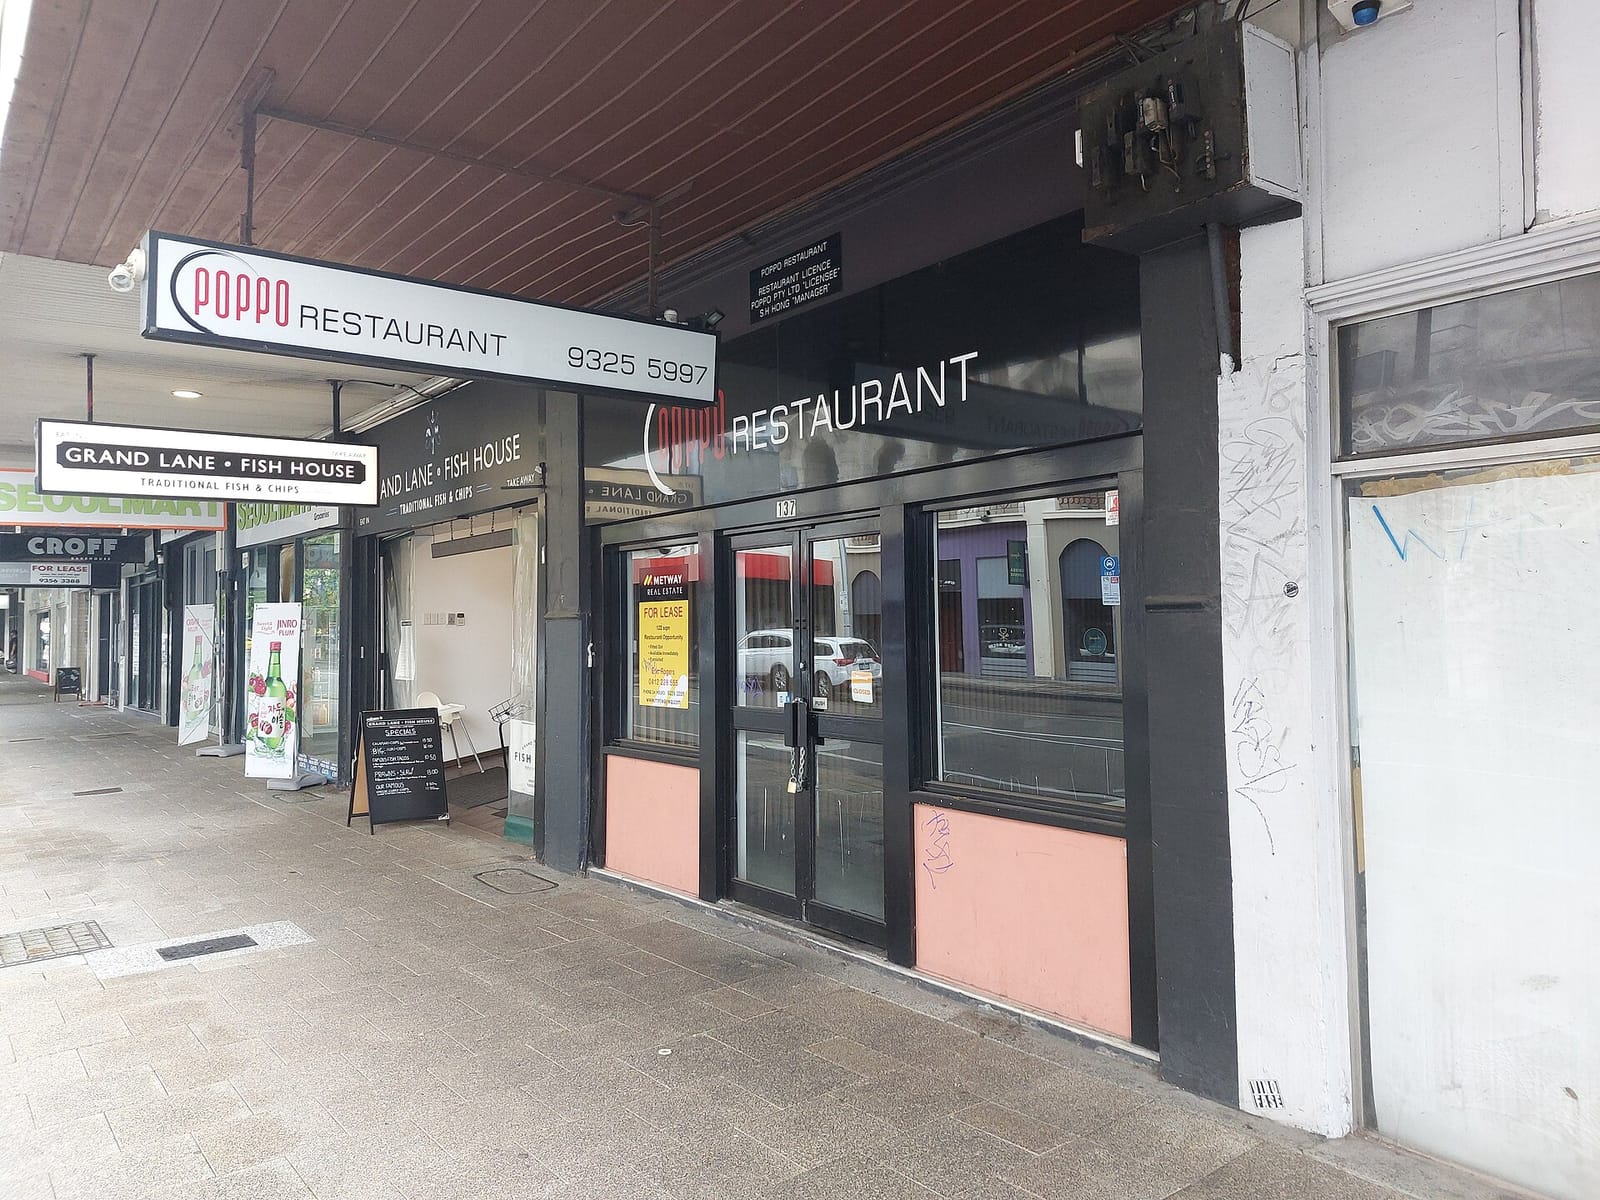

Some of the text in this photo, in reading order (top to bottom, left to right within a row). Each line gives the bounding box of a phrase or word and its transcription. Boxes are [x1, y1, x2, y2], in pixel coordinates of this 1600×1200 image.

[761, 241, 828, 277] POPPO RESTAURANT
[758, 259, 831, 296] RESTAURANT LICENCE
[751, 295, 772, 310] POPPO
[773, 290, 786, 301] PTY
[787, 283, 801, 296] LTD
[771, 299, 790, 313] HONG
[194, 267, 708, 386] POPPO RESTAURANT 9325 5997
[732, 351, 979, 454] RESTAURANT
[65, 447, 355, 478] GRAND LANE FISH HOUSE
[405, 463, 433, 489] LANE
[444, 451, 469, 481] FISH
[473, 434, 521, 472] HOUSE
[141, 477, 299, 494] TRADITIONAL FISH & CHIPS
[506, 477, 519, 487] TAKE
[399, 485, 473, 515] TRADITIONAL FISH & CHIPS
[779, 501, 795, 517] 137
[27, 537, 118, 555] CROFF
[57, 565, 88, 573] LEASE
[653, 574, 682, 586] METWAY
[647, 586, 683, 596] REAL ESTATE
[644, 606, 683, 619] FOR LEASE
[277, 619, 298, 631] JINRO
[384, 728, 417, 736] SPECIALS
[514, 752, 532, 764] FISH
